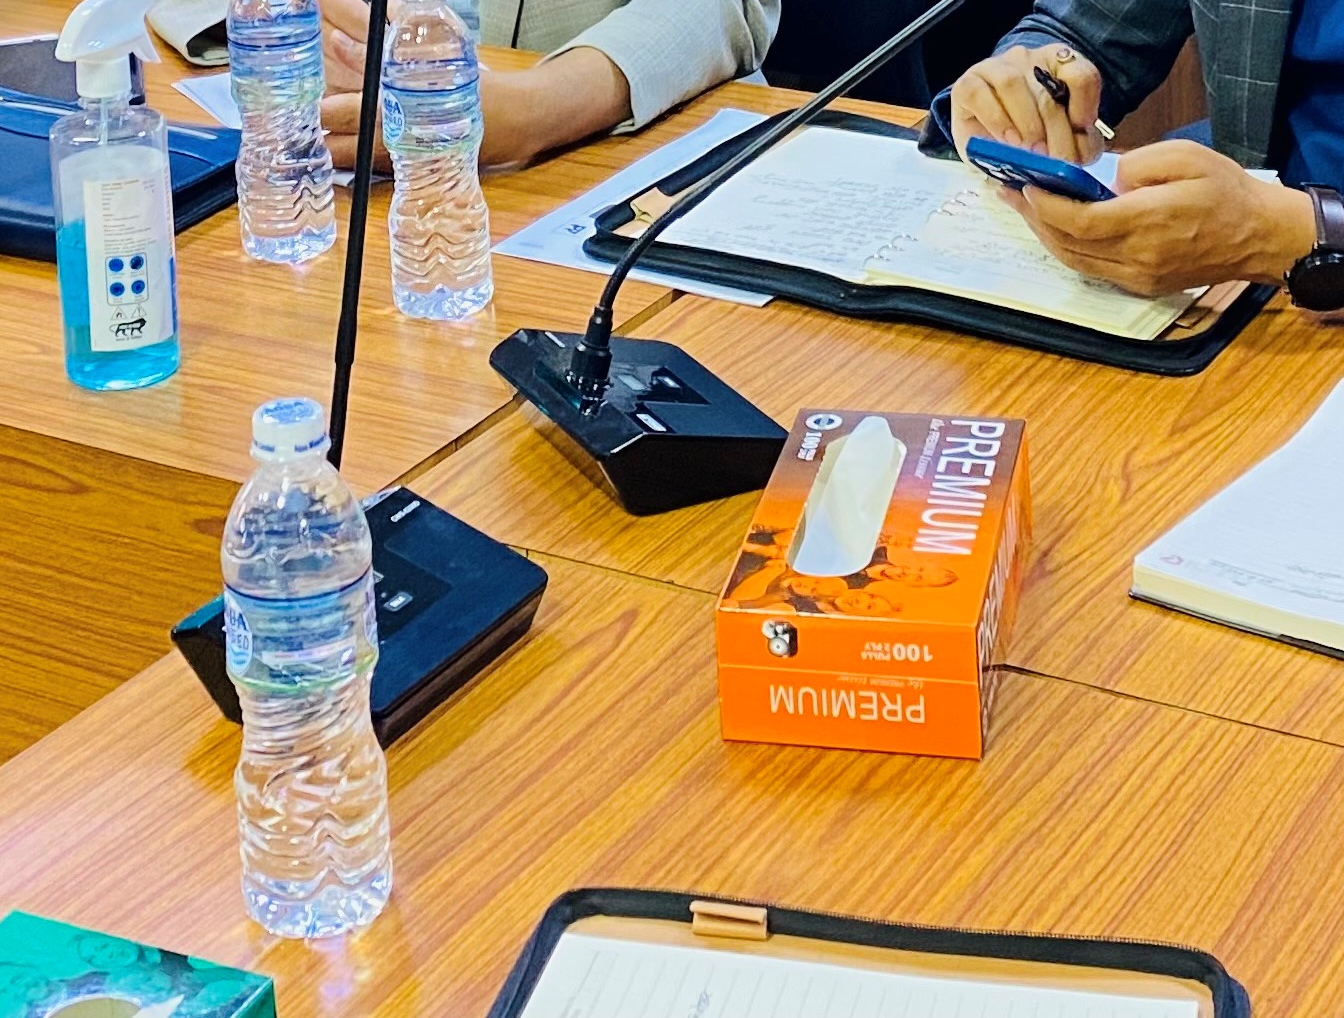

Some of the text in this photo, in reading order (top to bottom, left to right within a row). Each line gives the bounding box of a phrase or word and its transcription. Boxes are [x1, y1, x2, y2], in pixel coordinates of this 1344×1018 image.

[912, 419, 1006, 556] PREMIUM
[893, 643, 933, 662] 100
[769, 684, 926, 723] PREMIUM
